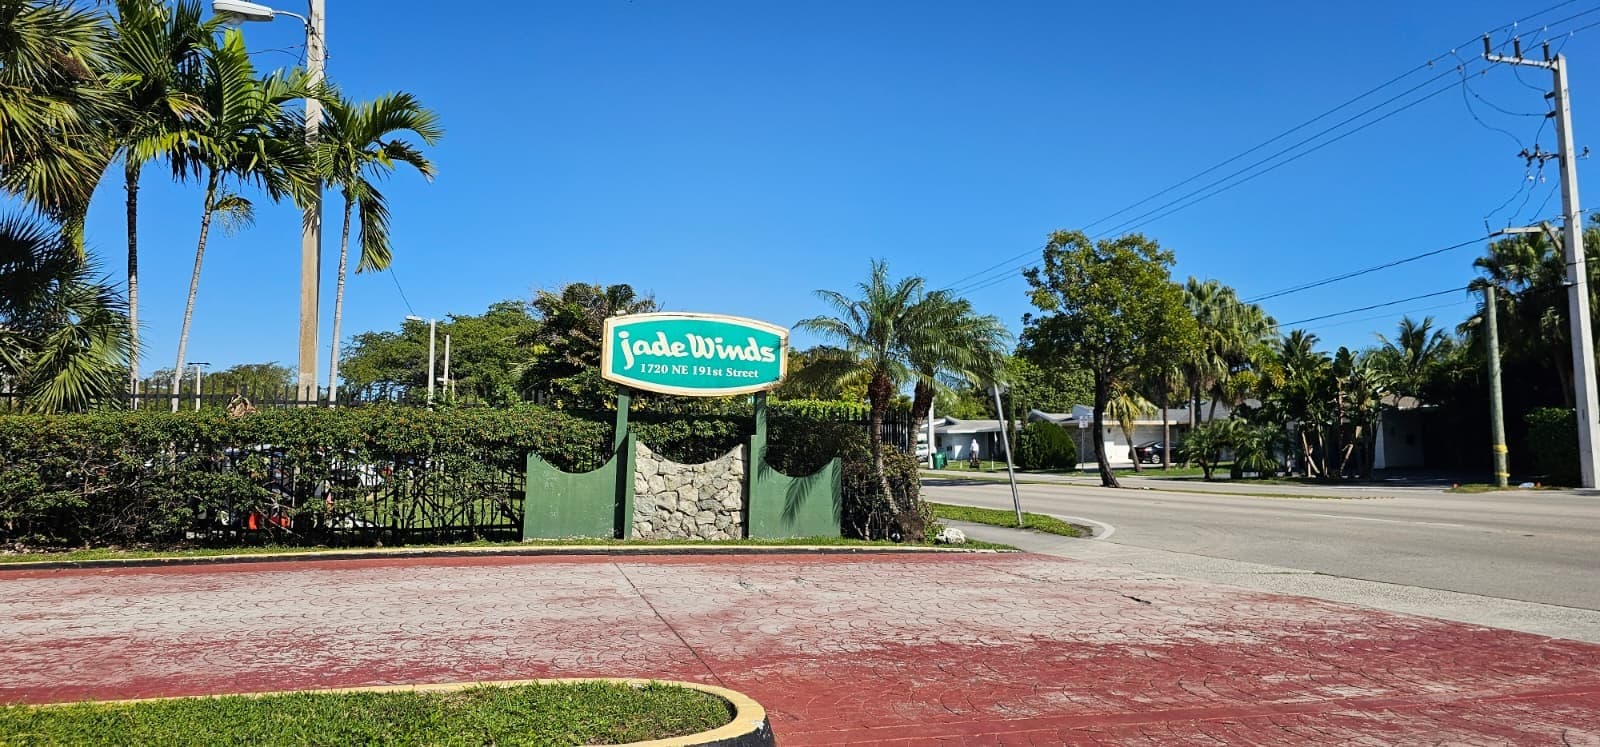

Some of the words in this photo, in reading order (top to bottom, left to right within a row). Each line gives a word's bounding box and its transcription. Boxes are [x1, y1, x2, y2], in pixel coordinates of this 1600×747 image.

[618, 330, 688, 370] jade
[686, 333, 776, 363] Winds
[640, 363, 669, 374] 1720
[671, 365, 689, 375] NE
[692, 366, 723, 377] 191st
[726, 368, 759, 378] Street
